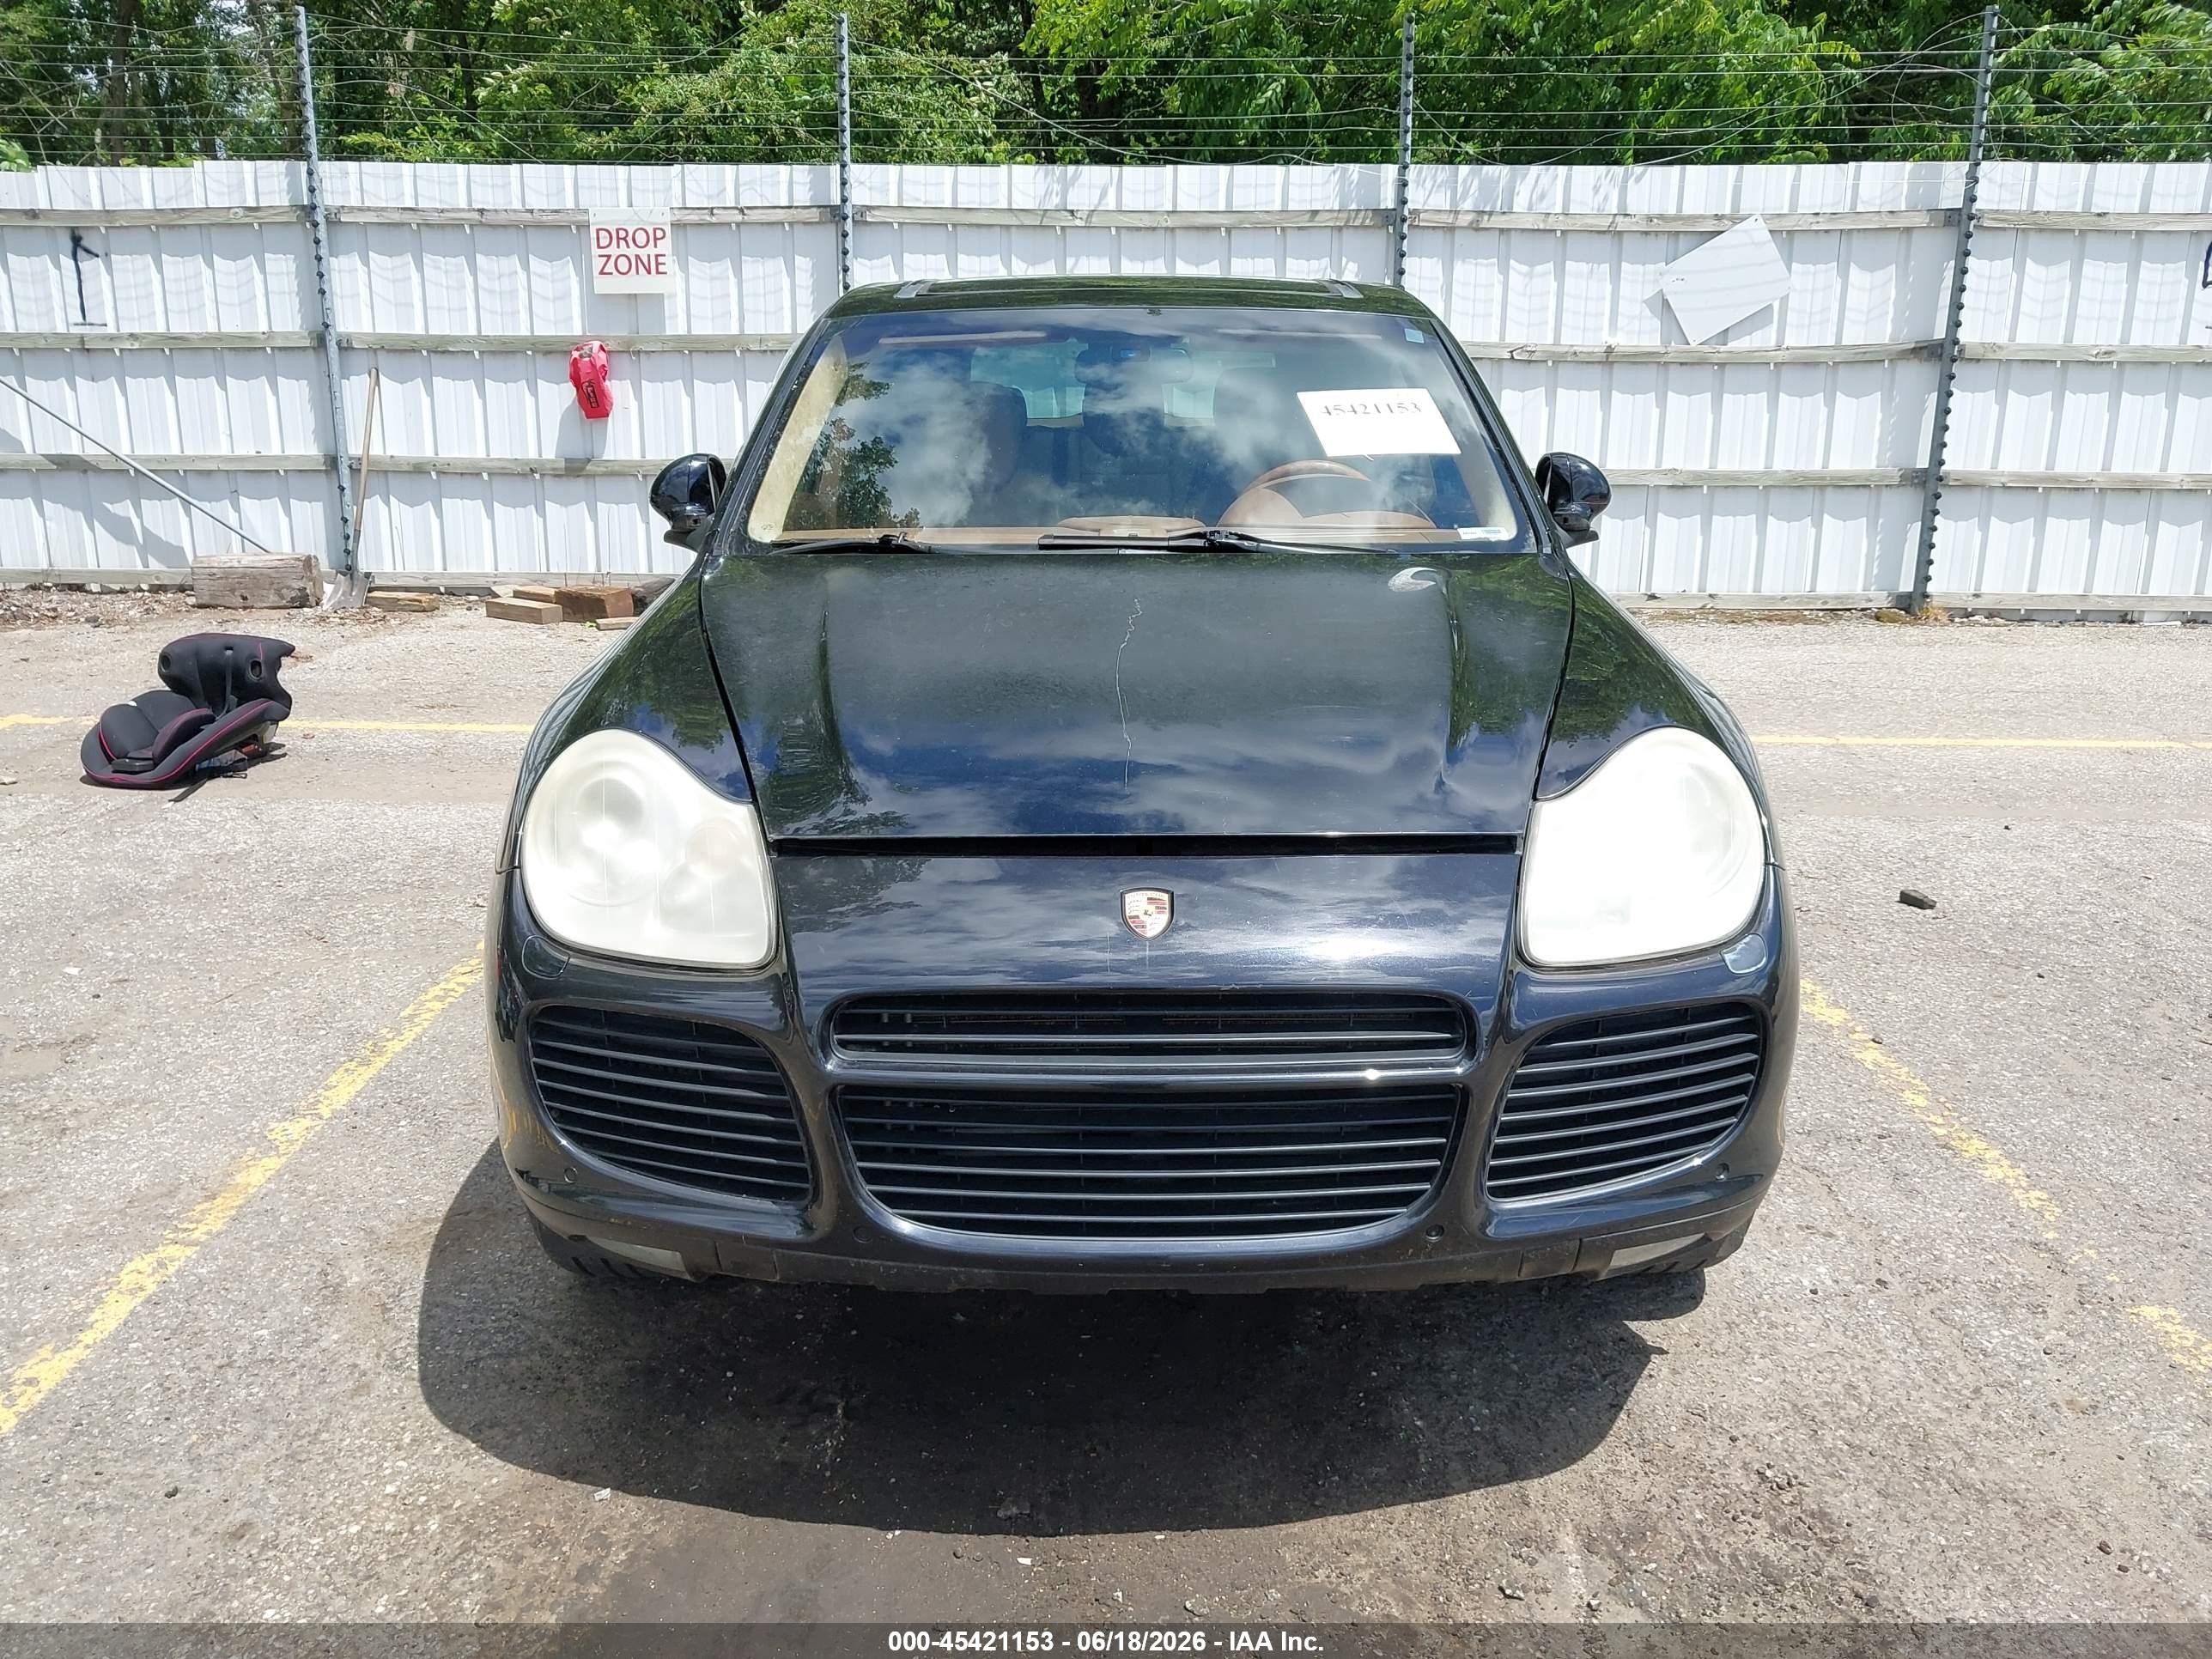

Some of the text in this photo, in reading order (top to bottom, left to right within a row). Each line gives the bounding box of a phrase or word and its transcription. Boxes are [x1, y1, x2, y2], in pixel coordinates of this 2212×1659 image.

[595, 227, 666, 249] DROP
[597, 253, 668, 276] ZONE
[1322, 401, 1422, 416] 45421153
